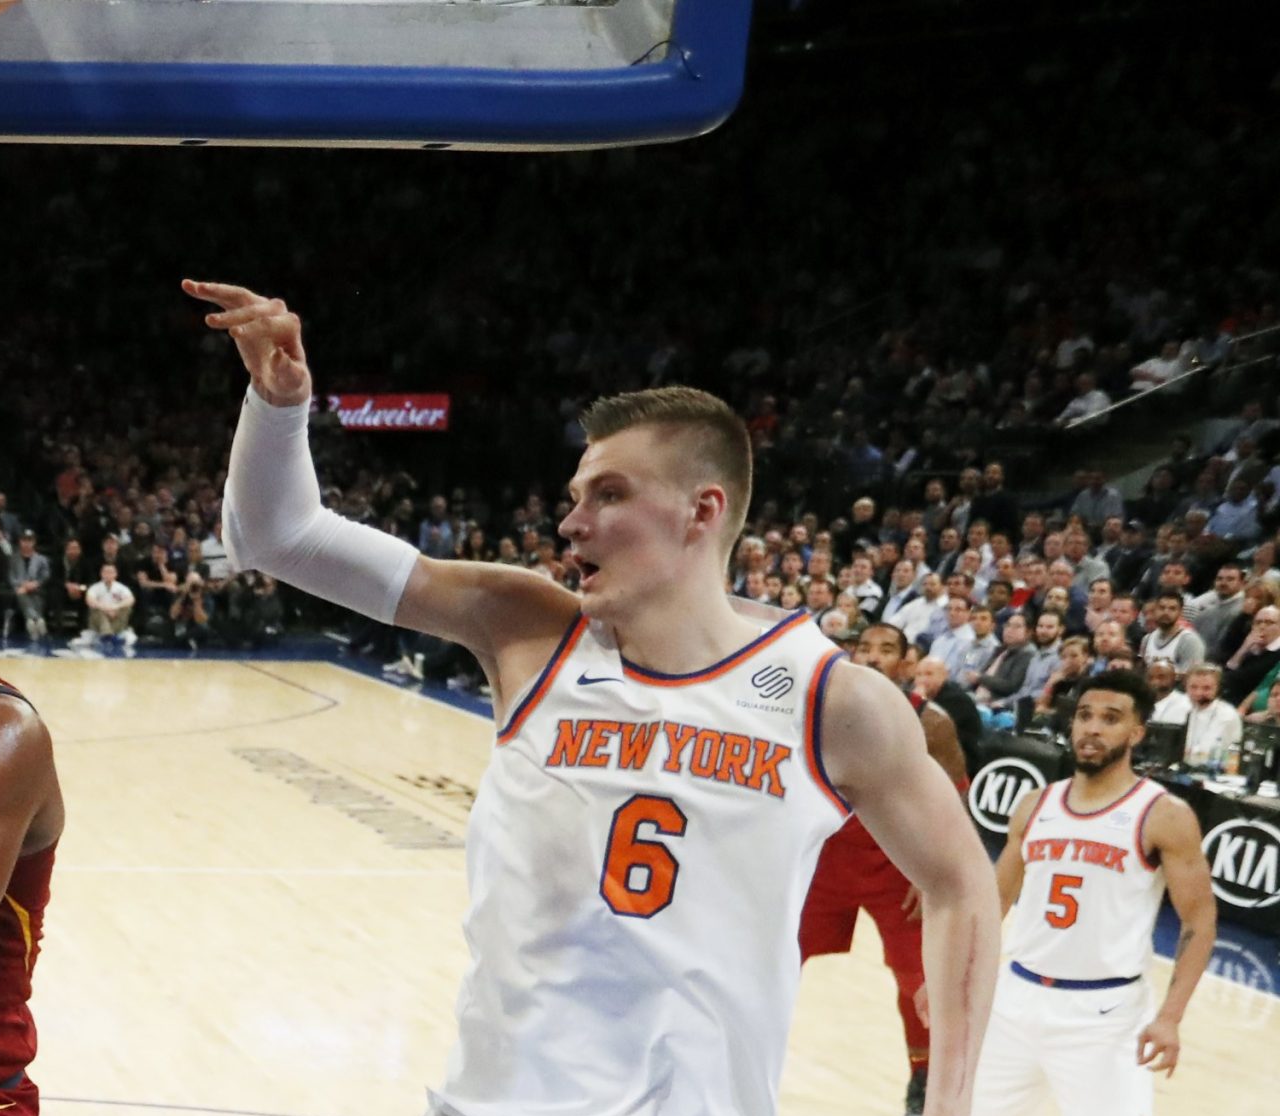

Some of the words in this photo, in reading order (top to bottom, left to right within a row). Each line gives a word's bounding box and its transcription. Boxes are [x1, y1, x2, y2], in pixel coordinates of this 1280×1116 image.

[736, 700, 794, 715] SQUARESPACE
[545, 719, 660, 770] NEW
[662, 721, 792, 799] YORK
[599, 793, 688, 919] 6
[1026, 838, 1069, 864] NEW
[1070, 838, 1129, 874] YORK
[1211, 831, 1279, 894] KIA
[1044, 873, 1084, 930] 5
